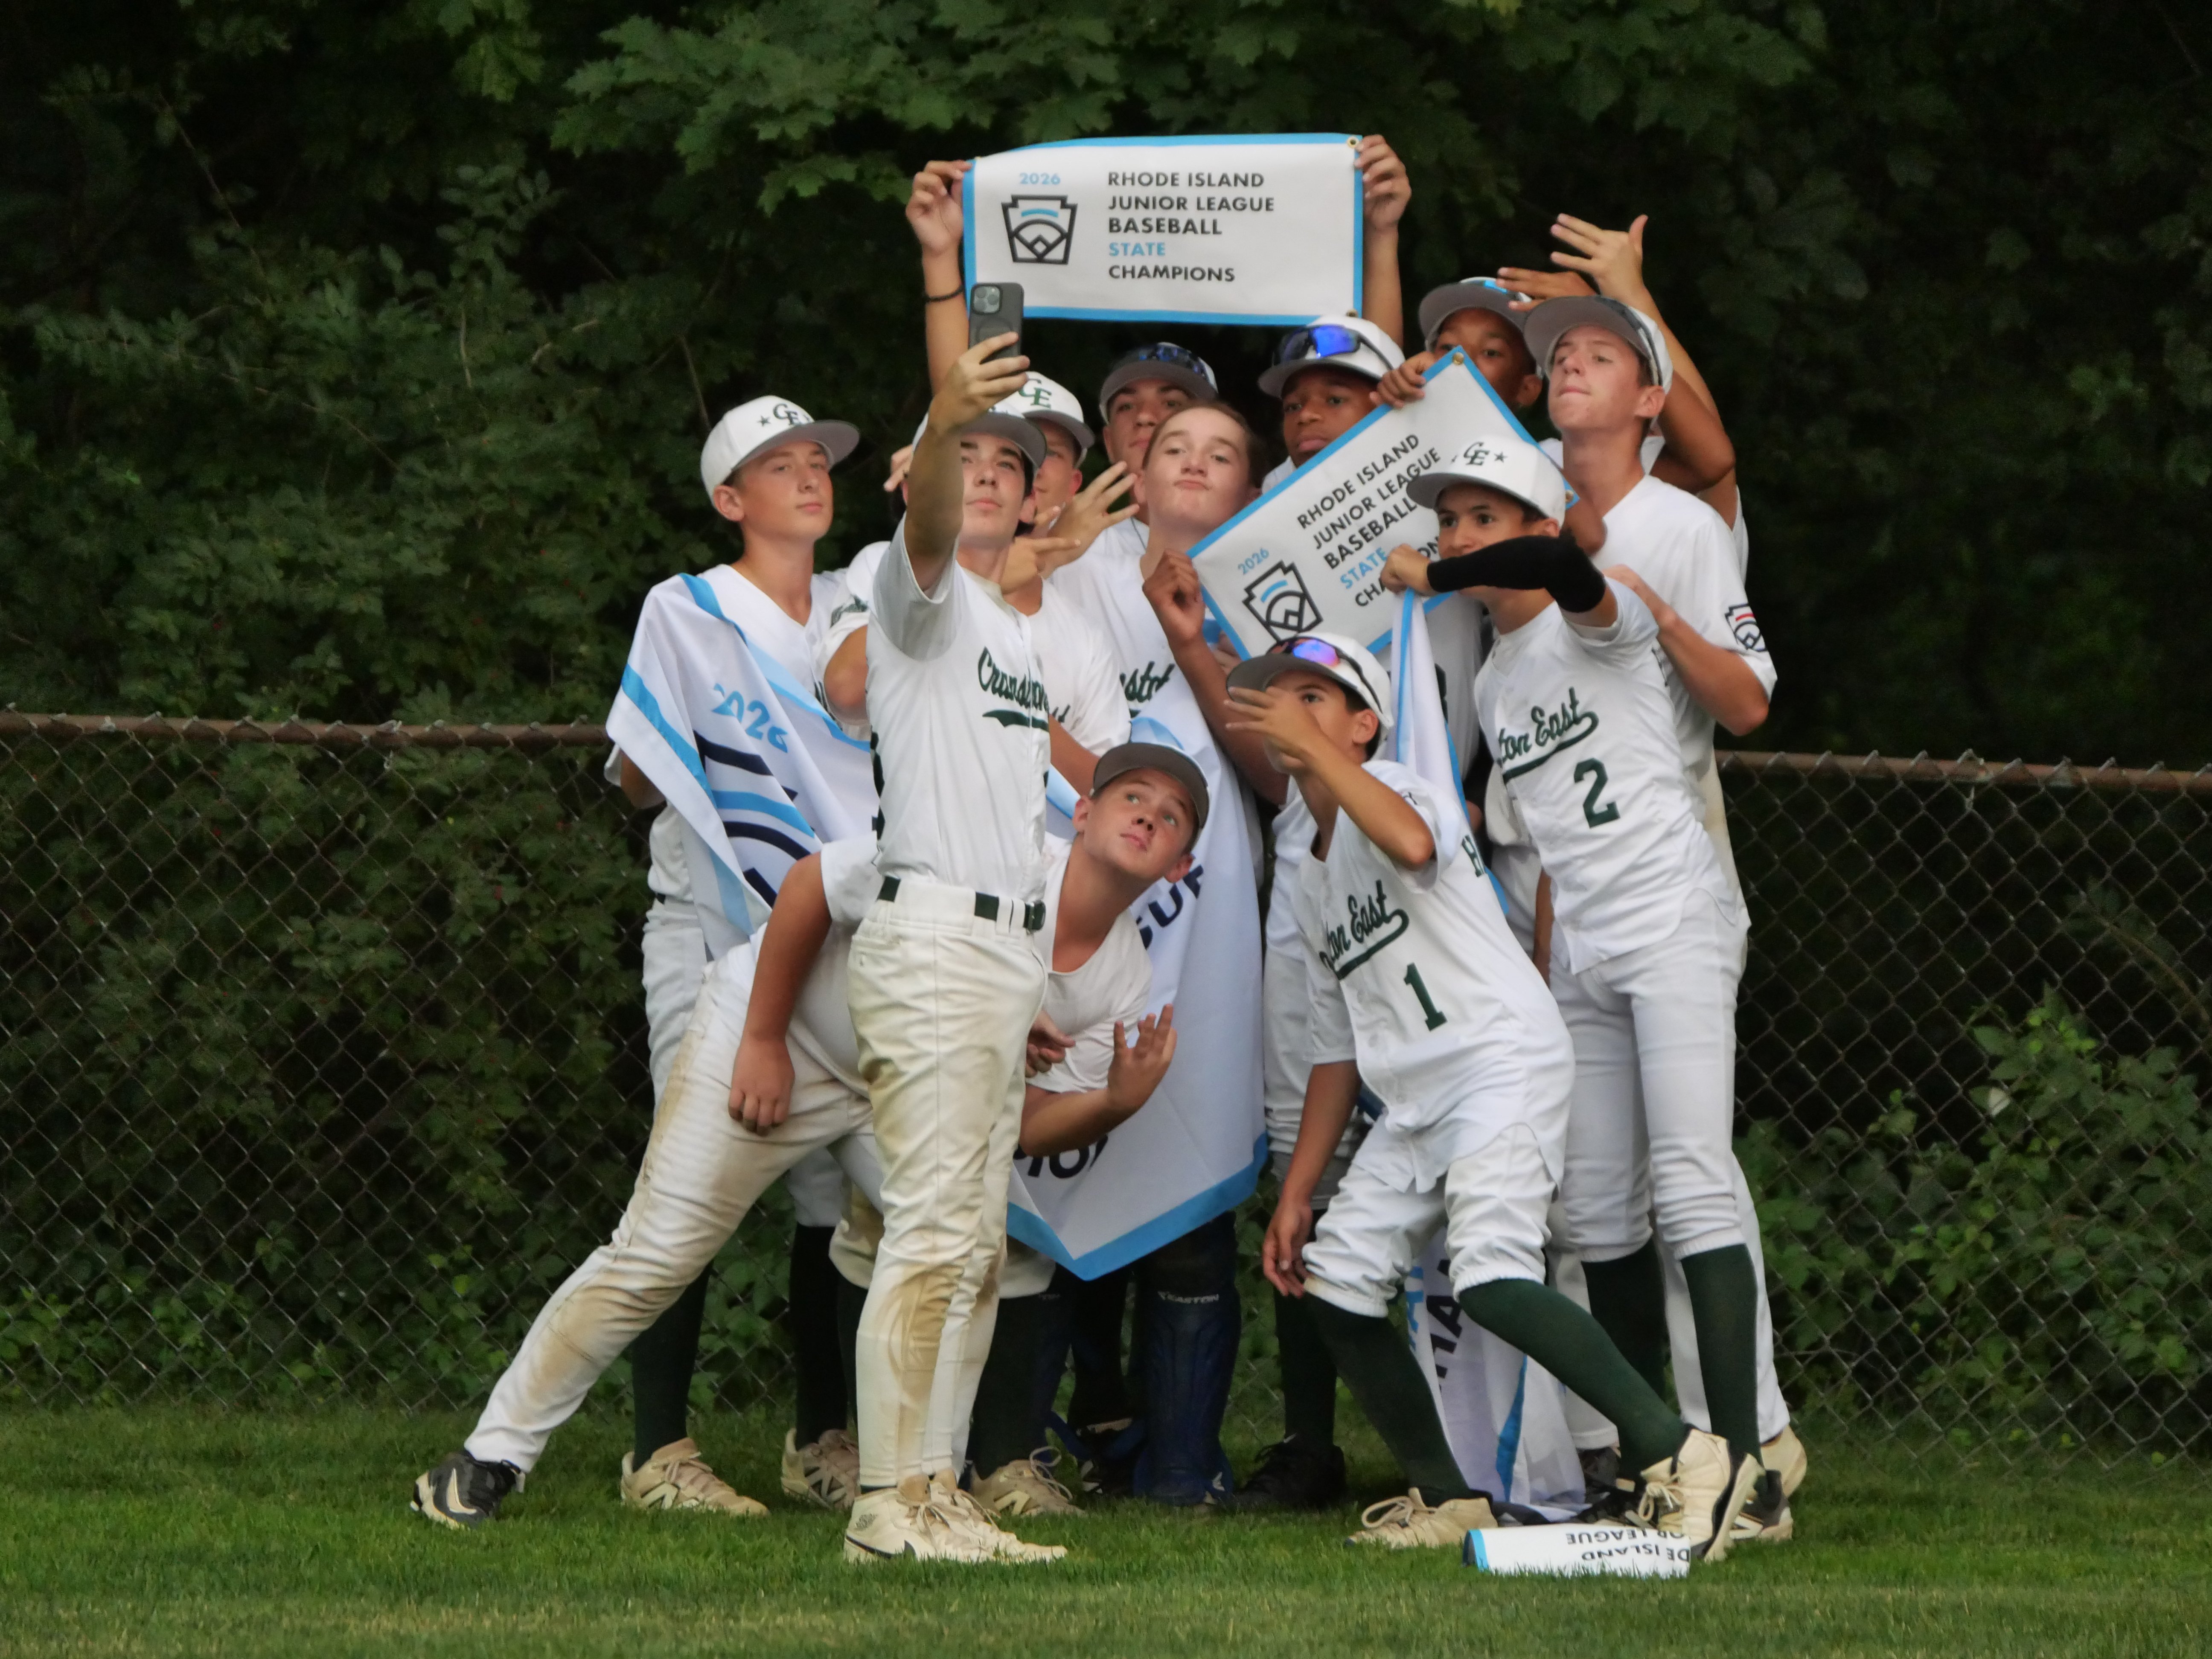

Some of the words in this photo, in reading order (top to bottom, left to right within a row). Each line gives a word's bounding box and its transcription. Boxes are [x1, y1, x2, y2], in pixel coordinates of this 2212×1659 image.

[1019, 172, 1061, 185] 2026
[1108, 172, 1180, 187] RHODE
[1188, 172, 1265, 188] ISLAND
[1108, 195, 1188, 210] JUNIOR
[1196, 196, 1275, 212] LEAGUE
[1109, 217, 1223, 235] BASEBALL
[1109, 242, 1166, 256] STATE
[1109, 265, 1236, 282] CHAMPIONS
[1297, 480, 1356, 529] RHODE
[1356, 434, 1420, 485] ISLAND
[1313, 496, 1377, 550] JUNIOR
[1377, 448, 1441, 501] LEAGUE
[1324, 497, 1418, 569] BASEBALL
[1237, 547, 1270, 576] 2026
[1340, 547, 1387, 590] STATE
[1531, 686, 1580, 747] East
[1574, 757, 1621, 829] 2
[1347, 879, 1390, 944] East
[1403, 962, 1448, 1032] 1
[1566, 1529, 1648, 1545] LEAGUE
[1581, 1544, 1660, 1562] ISLAND
